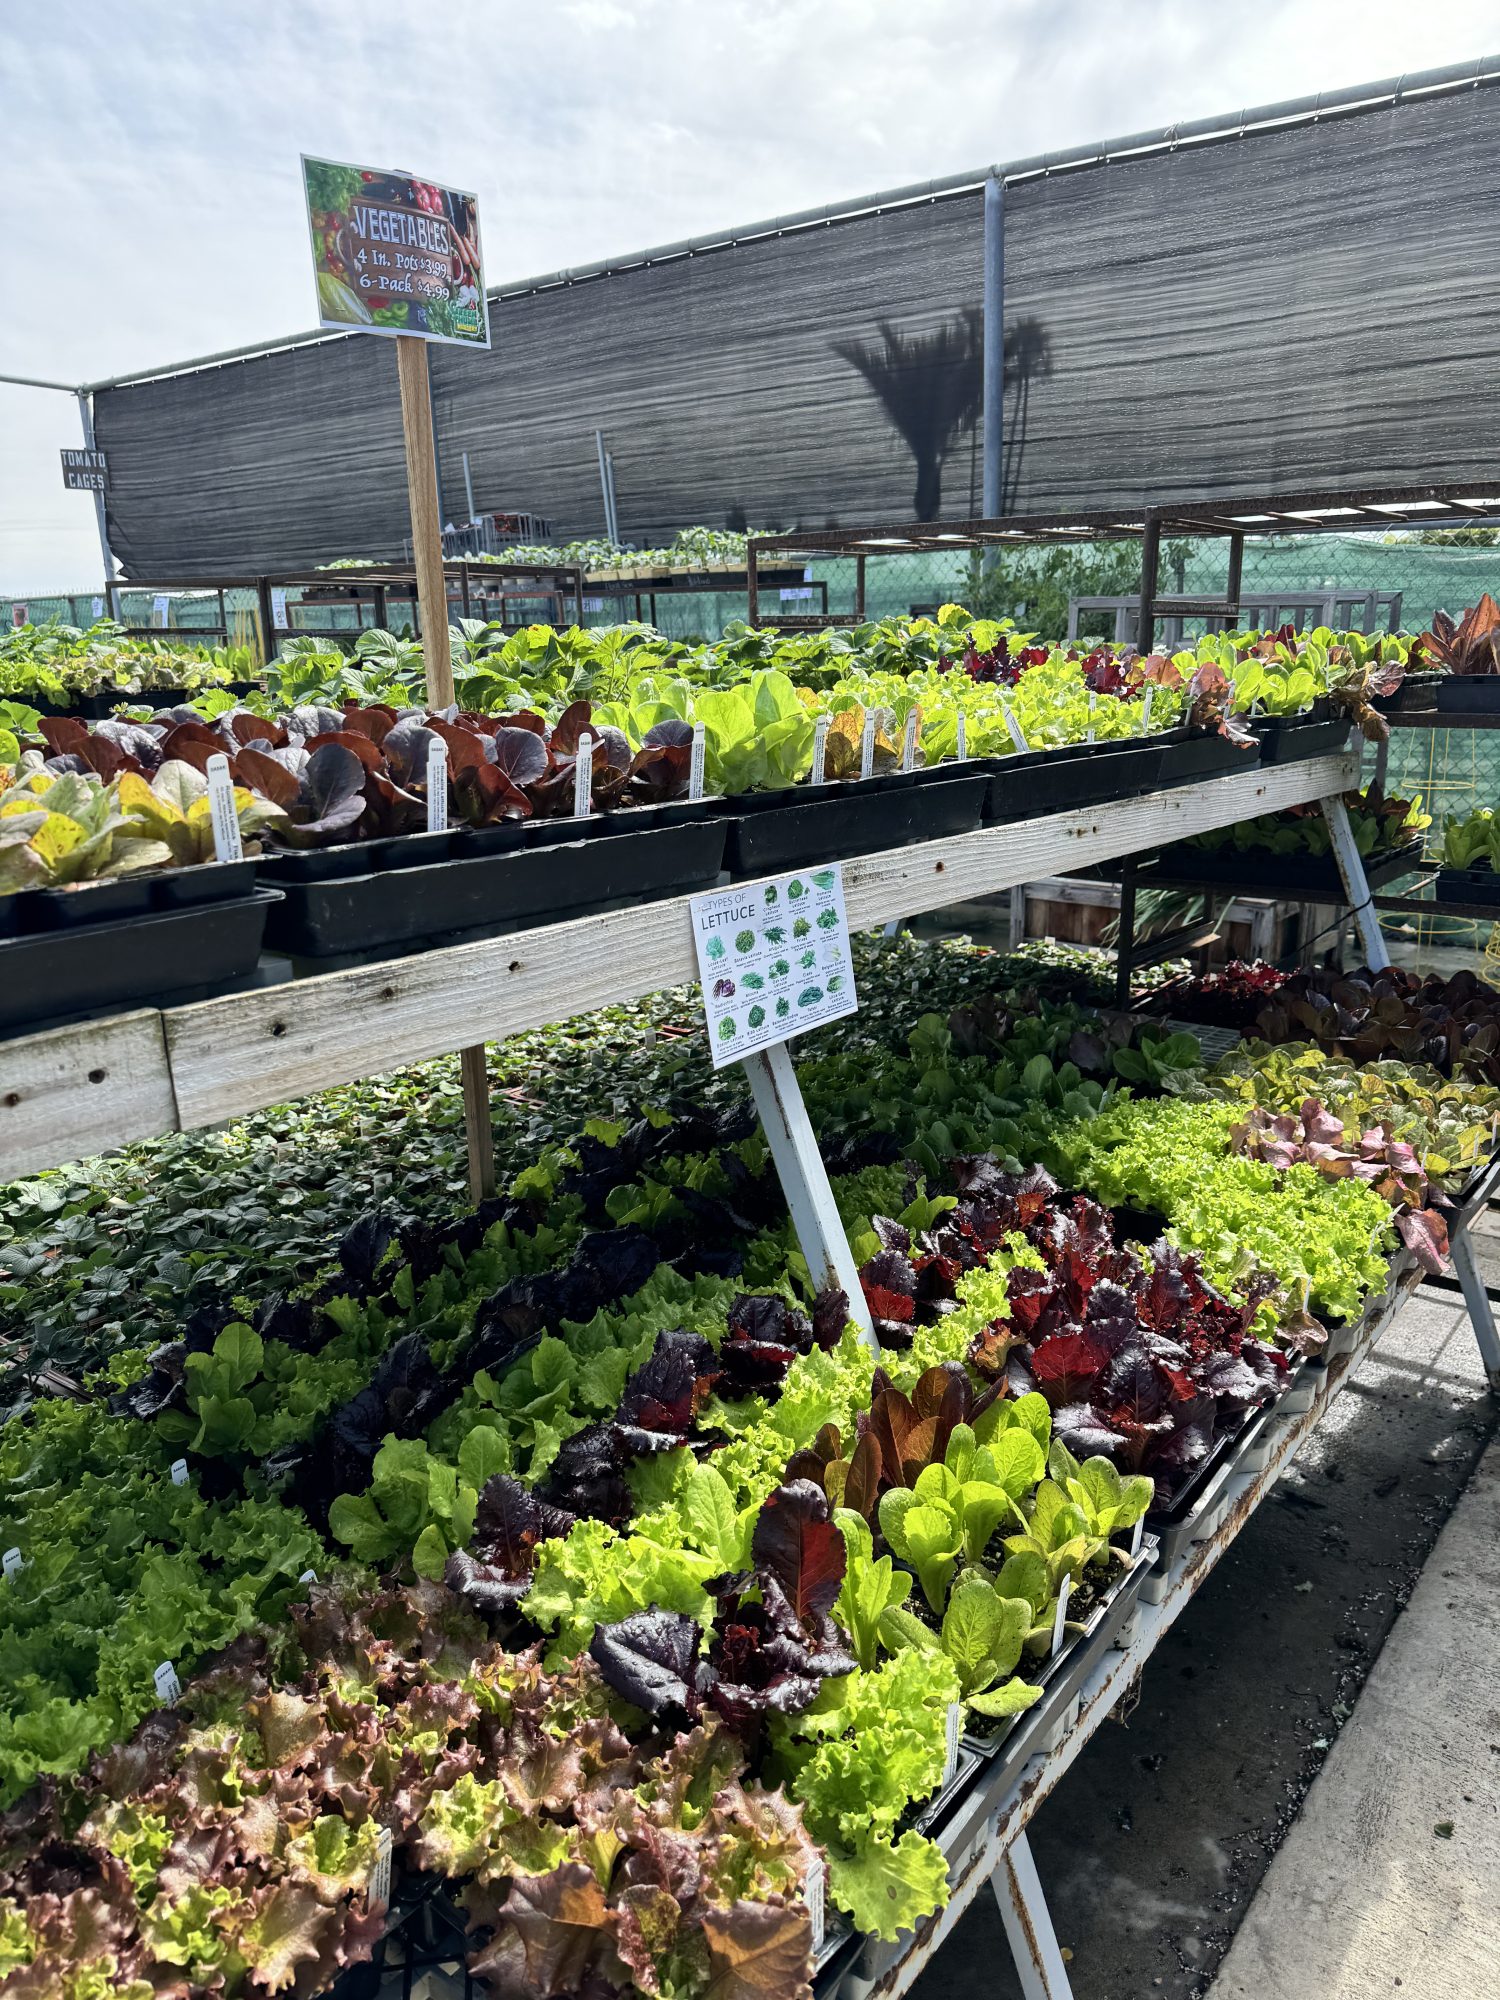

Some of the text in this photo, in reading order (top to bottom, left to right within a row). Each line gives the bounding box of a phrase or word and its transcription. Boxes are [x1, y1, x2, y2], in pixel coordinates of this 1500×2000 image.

[353, 205, 449, 255] VEGETABLES
[357, 247, 447, 277] 4 In. Pots $3.99
[359, 272, 450, 301] 6-Pack $4.99
[61, 450, 106, 468] TOMATO
[68, 472, 104, 489] CAGES
[707, 892, 747, 910] TYPES OF
[701, 904, 755, 931] LETTUCE
